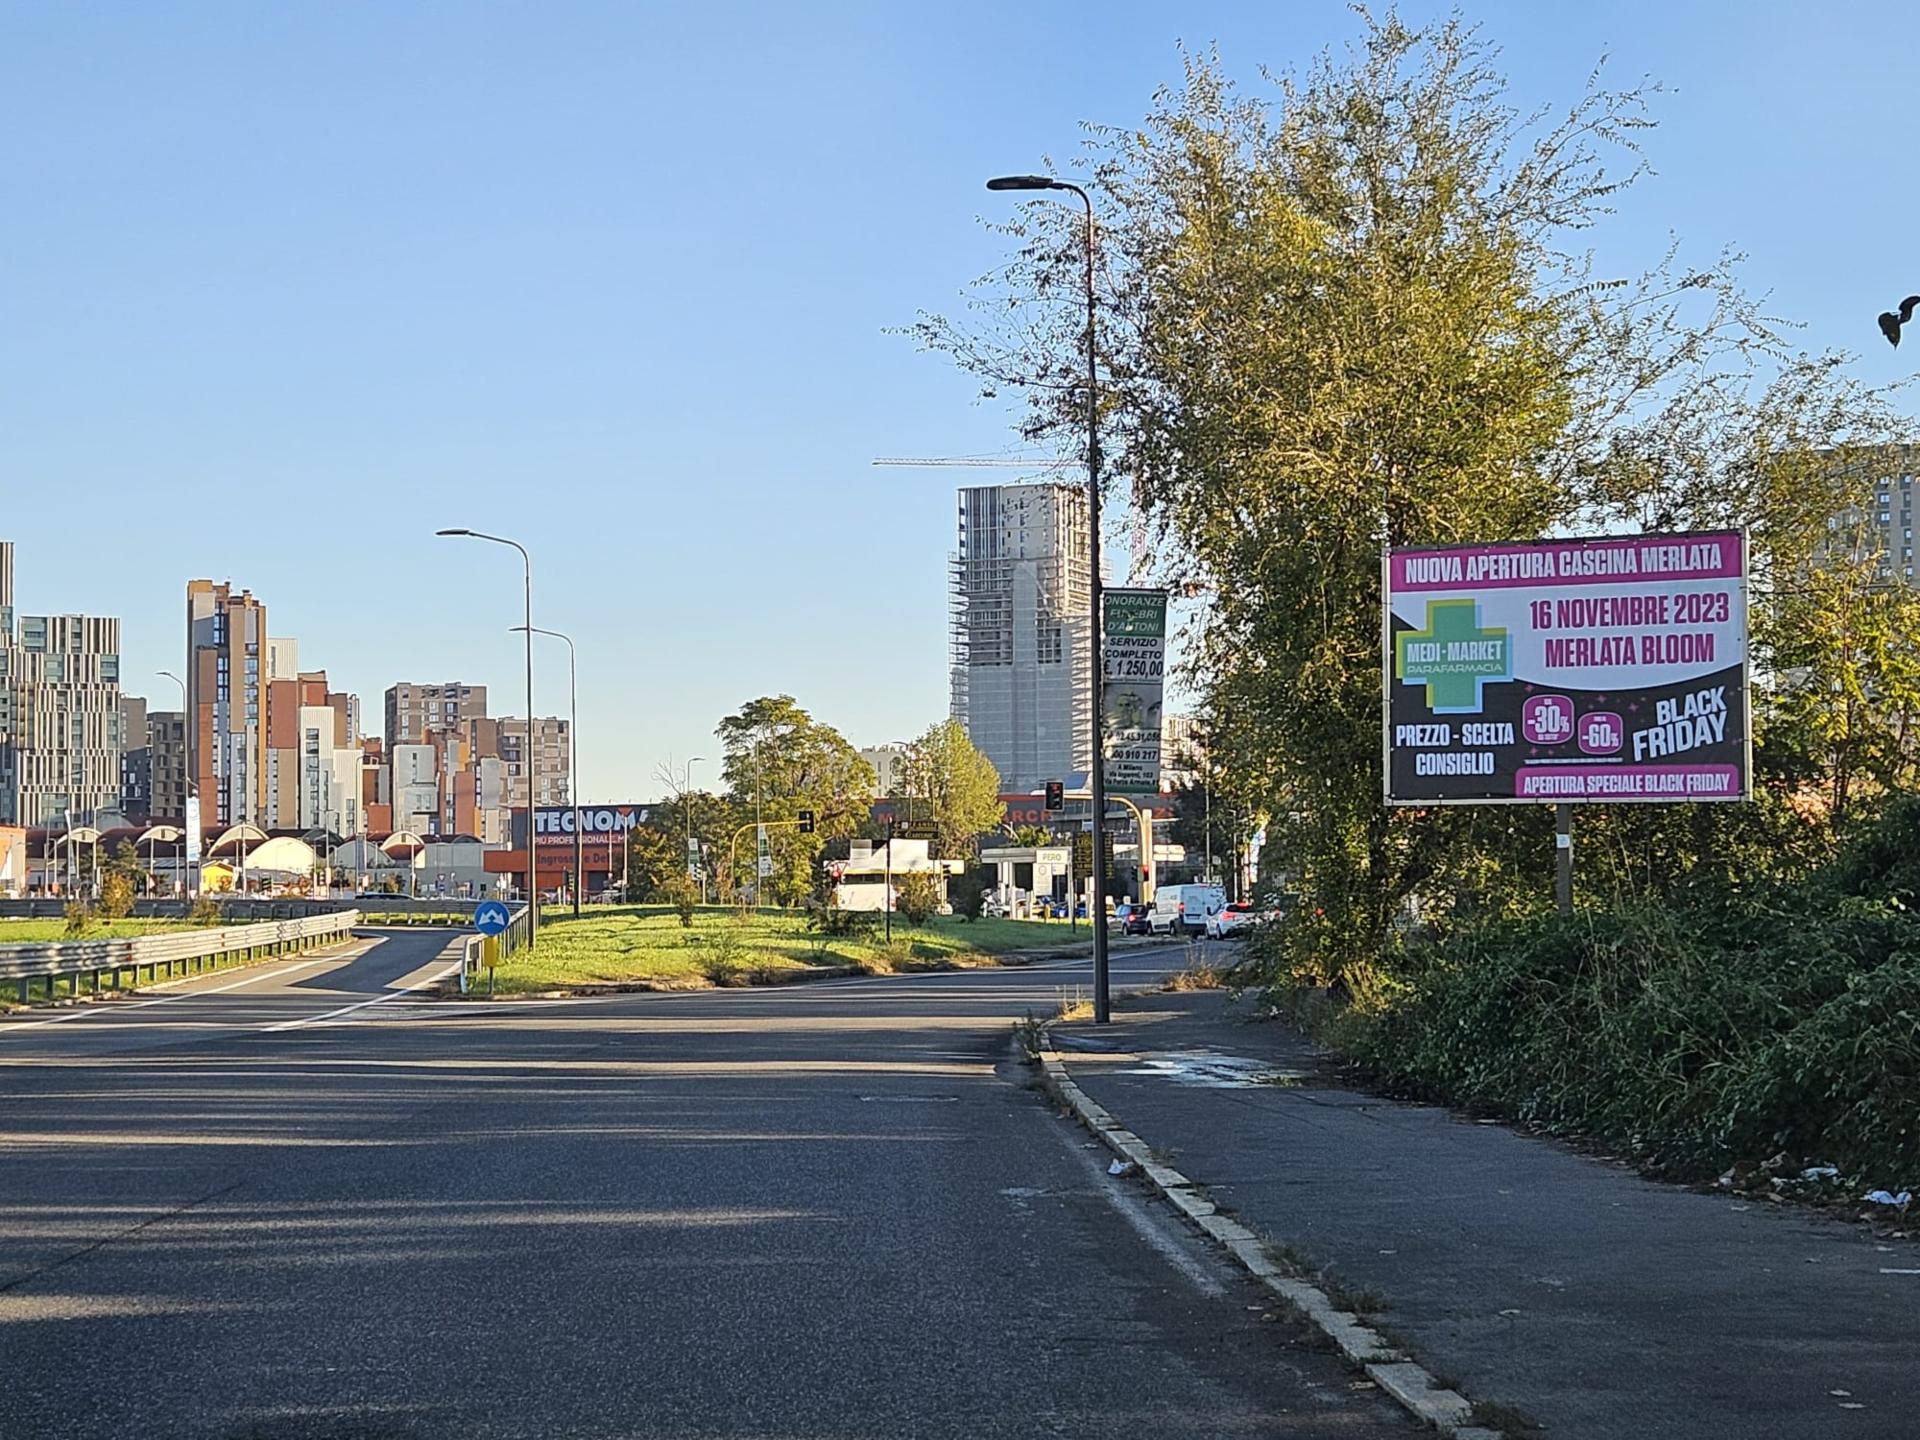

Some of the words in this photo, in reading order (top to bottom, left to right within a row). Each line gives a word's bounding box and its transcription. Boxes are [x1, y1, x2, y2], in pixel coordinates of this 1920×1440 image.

[1405, 557, 1461, 584] NUOVA
[1466, 551, 1556, 581] APERTURA
[1559, 547, 1637, 576] CASCINA
[1641, 543, 1722, 572] MERLATA
[1104, 596, 1165, 607] ONORANZE
[1530, 601, 1552, 630] 16
[1556, 596, 1669, 629] NOVEMBRE
[1674, 592, 1729, 623] 2023
[1110, 608, 1158, 619] FUEBRI
[1110, 637, 1158, 647] SERVIZIO
[1545, 637, 1636, 668] MERLATA
[1641, 633, 1714, 664] BLOOM
[1105, 649, 1162, 659] COMPLETO
[1117, 660, 1163, 678] 1.250,00
[1407, 663, 1503, 674] PARAFARMACIA
[1656, 686, 1727, 726] BLACK
[1527, 705, 1569, 733] -30%
[1395, 724, 1451, 747] PREZZO
[1462, 723, 1514, 746] SCELTA
[1632, 711, 1727, 762] FRIDAY
[1125, 750, 1140, 759] 910
[1142, 750, 1157, 760] 217
[1416, 752, 1494, 776] CONSIGLIO
[1523, 776, 1586, 795] APERTURA
[1587, 774, 1643, 794] SPECIALE
[1645, 774, 1684, 793] BLACK
[1687, 773, 1729, 792] FRIDAY
